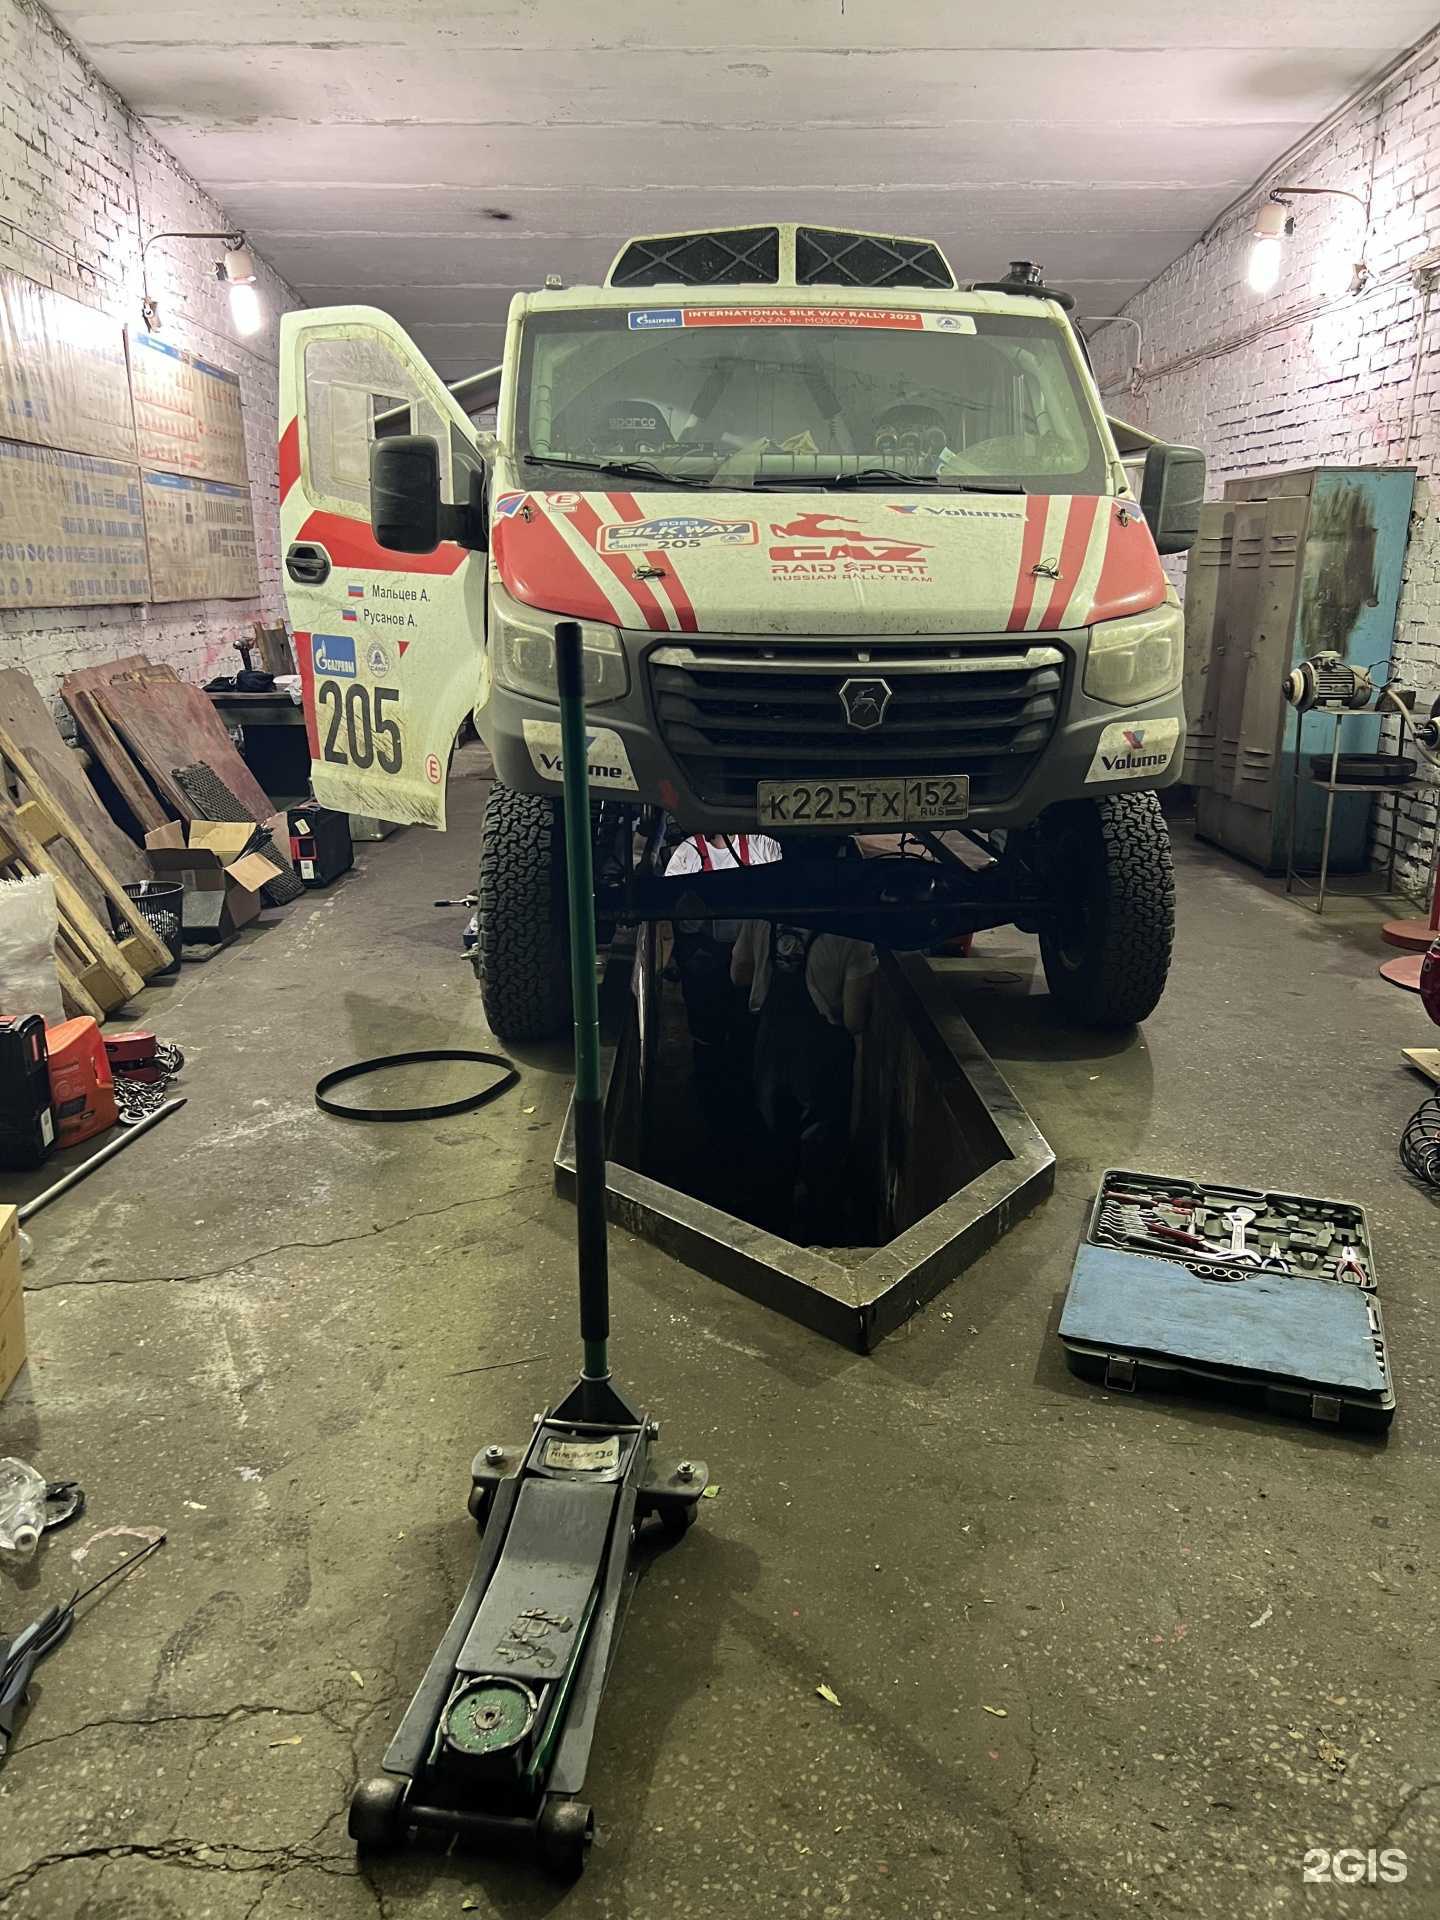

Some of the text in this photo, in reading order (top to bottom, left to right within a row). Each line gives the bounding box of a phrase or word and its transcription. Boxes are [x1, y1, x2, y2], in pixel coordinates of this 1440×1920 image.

[688, 310, 786, 318] INTERNATIONAL
[818, 310, 846, 318] WAY
[849, 311, 886, 319] RALLY
[889, 313, 917, 321] 2023
[804, 317, 859, 325] MOSCOW
[924, 507, 1023, 520] Volume
[615, 524, 743, 538] SILK WAY
[657, 539, 702, 549] 205
[768, 544, 928, 563] GAZ
[771, 562, 929, 575] RAID SPORT
[772, 574, 837, 582] RUSSIAN
[890, 575, 933, 583] TEAM
[372, 584, 431, 602] Мальцев А.
[363, 608, 418, 627] Русанов А.
[318, 679, 403, 775] 205
[430, 759, 438, 779] E
[540, 753, 622, 778] Vome
[1101, 752, 1167, 771] Volume
[909, 781, 958, 807] 152
[920, 806, 945, 816] RUS
